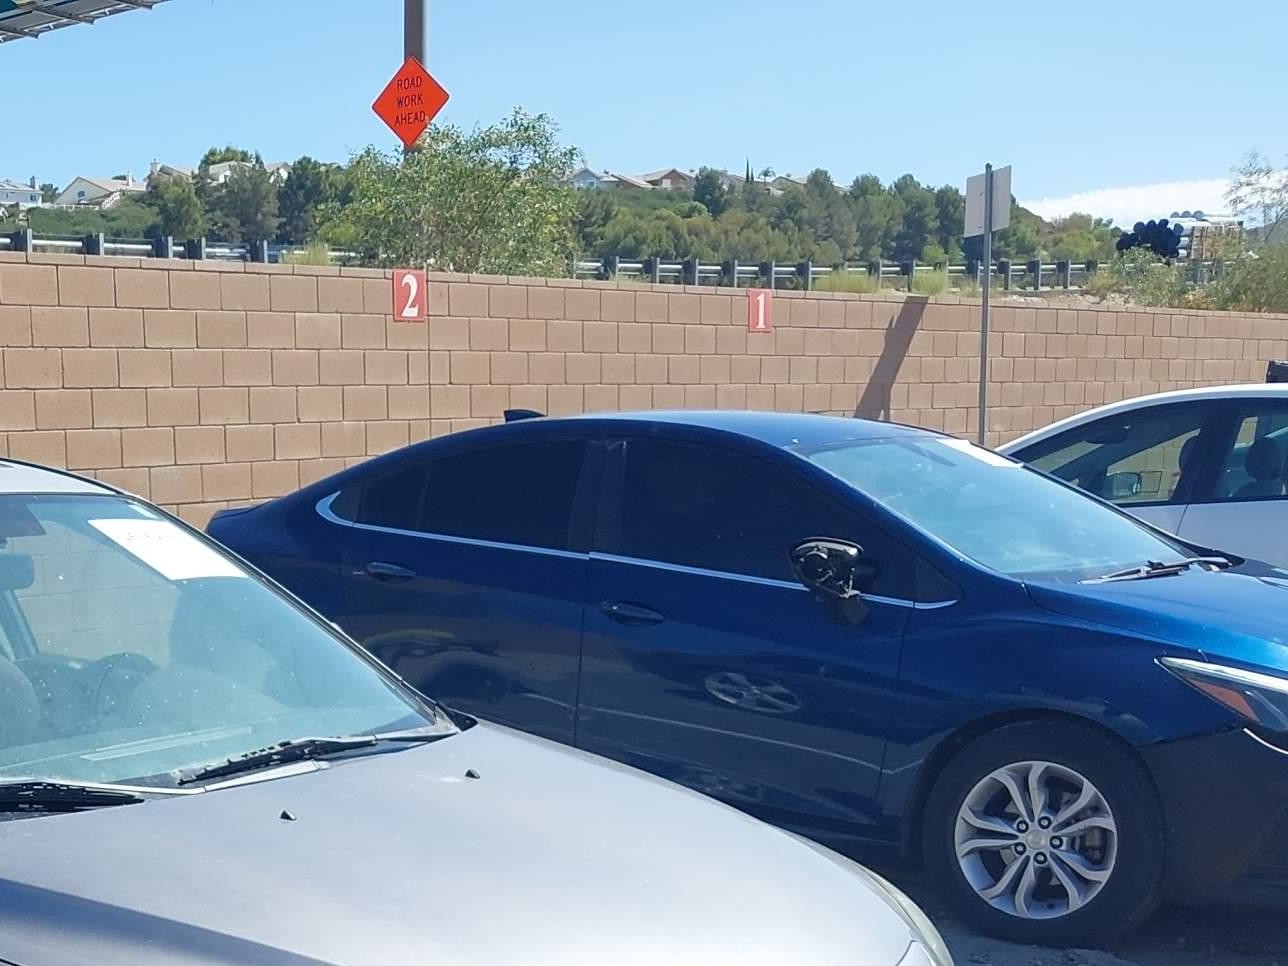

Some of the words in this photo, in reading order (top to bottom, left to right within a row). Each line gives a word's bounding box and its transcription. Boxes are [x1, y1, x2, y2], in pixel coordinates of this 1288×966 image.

[396, 76, 422, 91] ROAD
[396, 93, 424, 108] WORK
[394, 110, 426, 126] AHEAD
[401, 274, 419, 318] 2
[755, 292, 766, 329] 1
